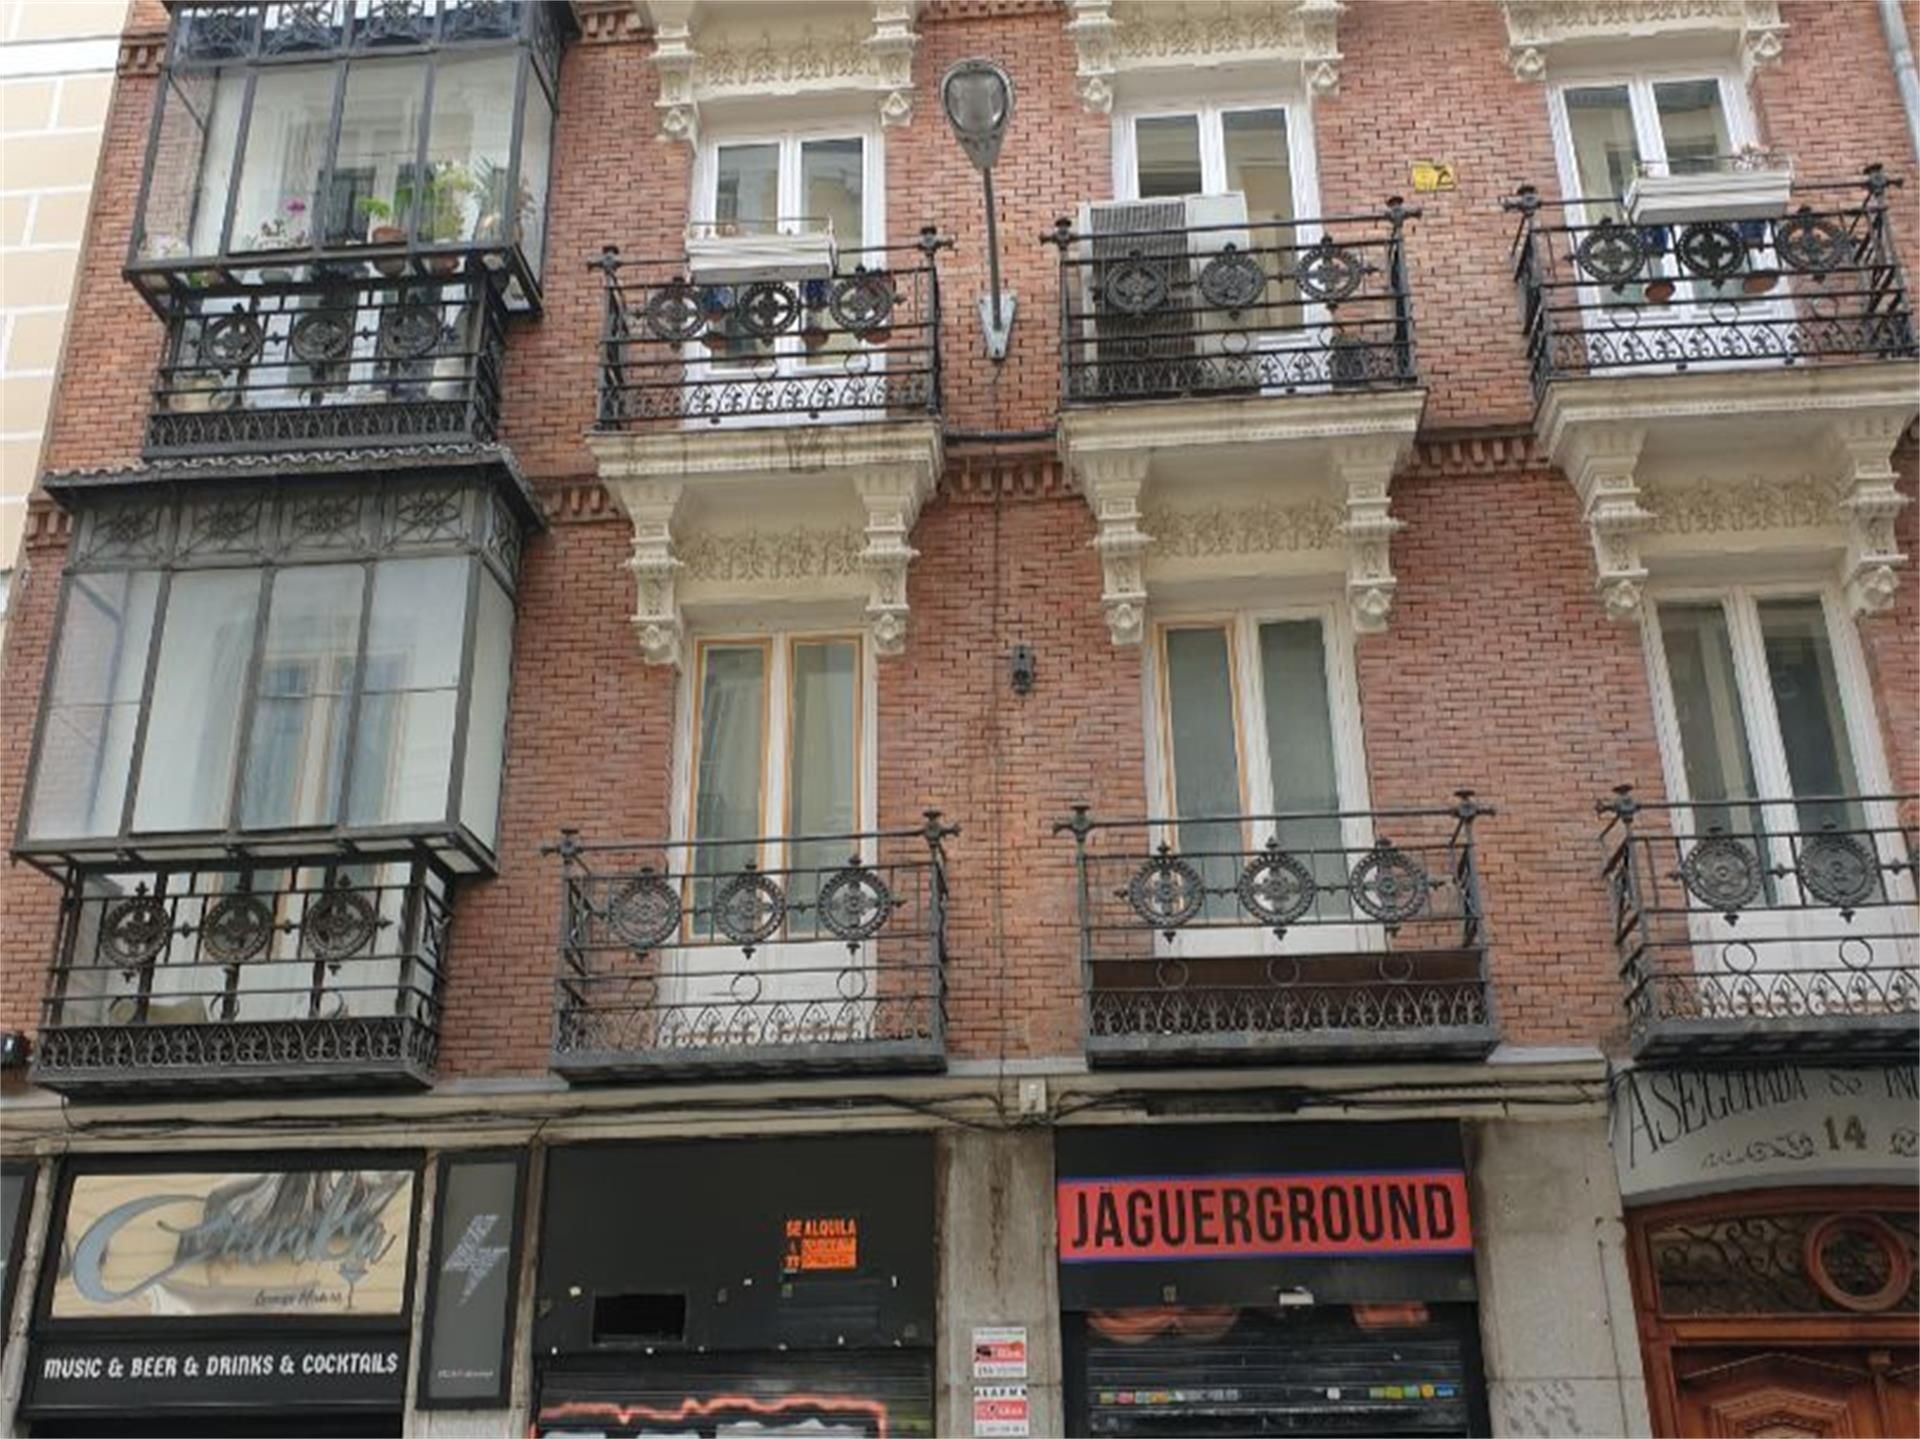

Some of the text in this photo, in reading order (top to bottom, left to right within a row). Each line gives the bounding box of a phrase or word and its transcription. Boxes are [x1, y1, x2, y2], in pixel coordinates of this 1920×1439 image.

[1823, 1116, 1867, 1151] 14
[804, 1217, 857, 1237] ALQUILA
[44, 1353, 399, 1379] MUSIC & BEER & DRINKS & COCKTAILS
